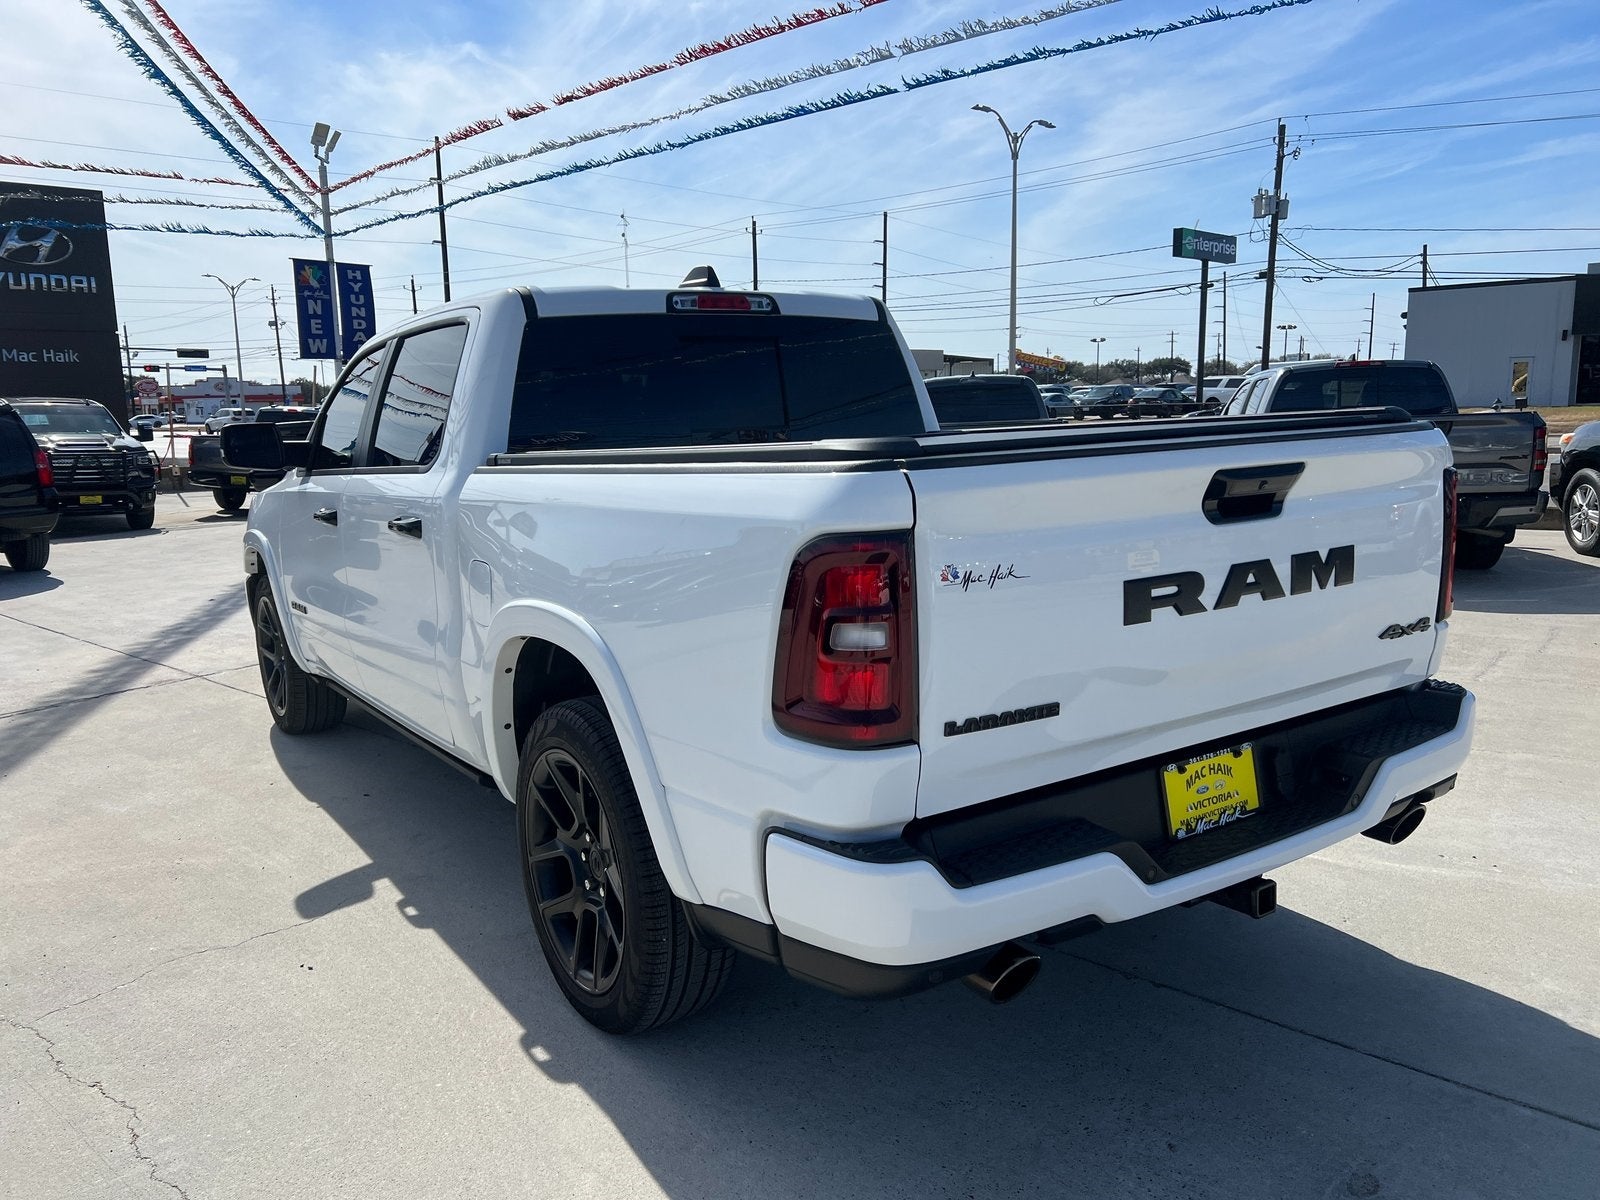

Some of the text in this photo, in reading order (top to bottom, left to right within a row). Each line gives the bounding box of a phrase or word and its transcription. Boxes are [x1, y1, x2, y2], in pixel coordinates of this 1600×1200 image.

[1185, 236, 1236, 256] enterprise
[346, 269, 368, 348] HYUNDA
[307, 299, 328, 354] NEW
[2, 349, 80, 363] Mac Haik
[960, 563, 1031, 592] Mac Haik
[1123, 544, 1355, 627] RAM
[943, 701, 1060, 737] LARAMIE
[1185, 766, 1206, 792] MAC
[1208, 763, 1234, 778] HAIK
[1192, 791, 1233, 811] VICTORIA
[1195, 805, 1255, 834] Mac Haik
